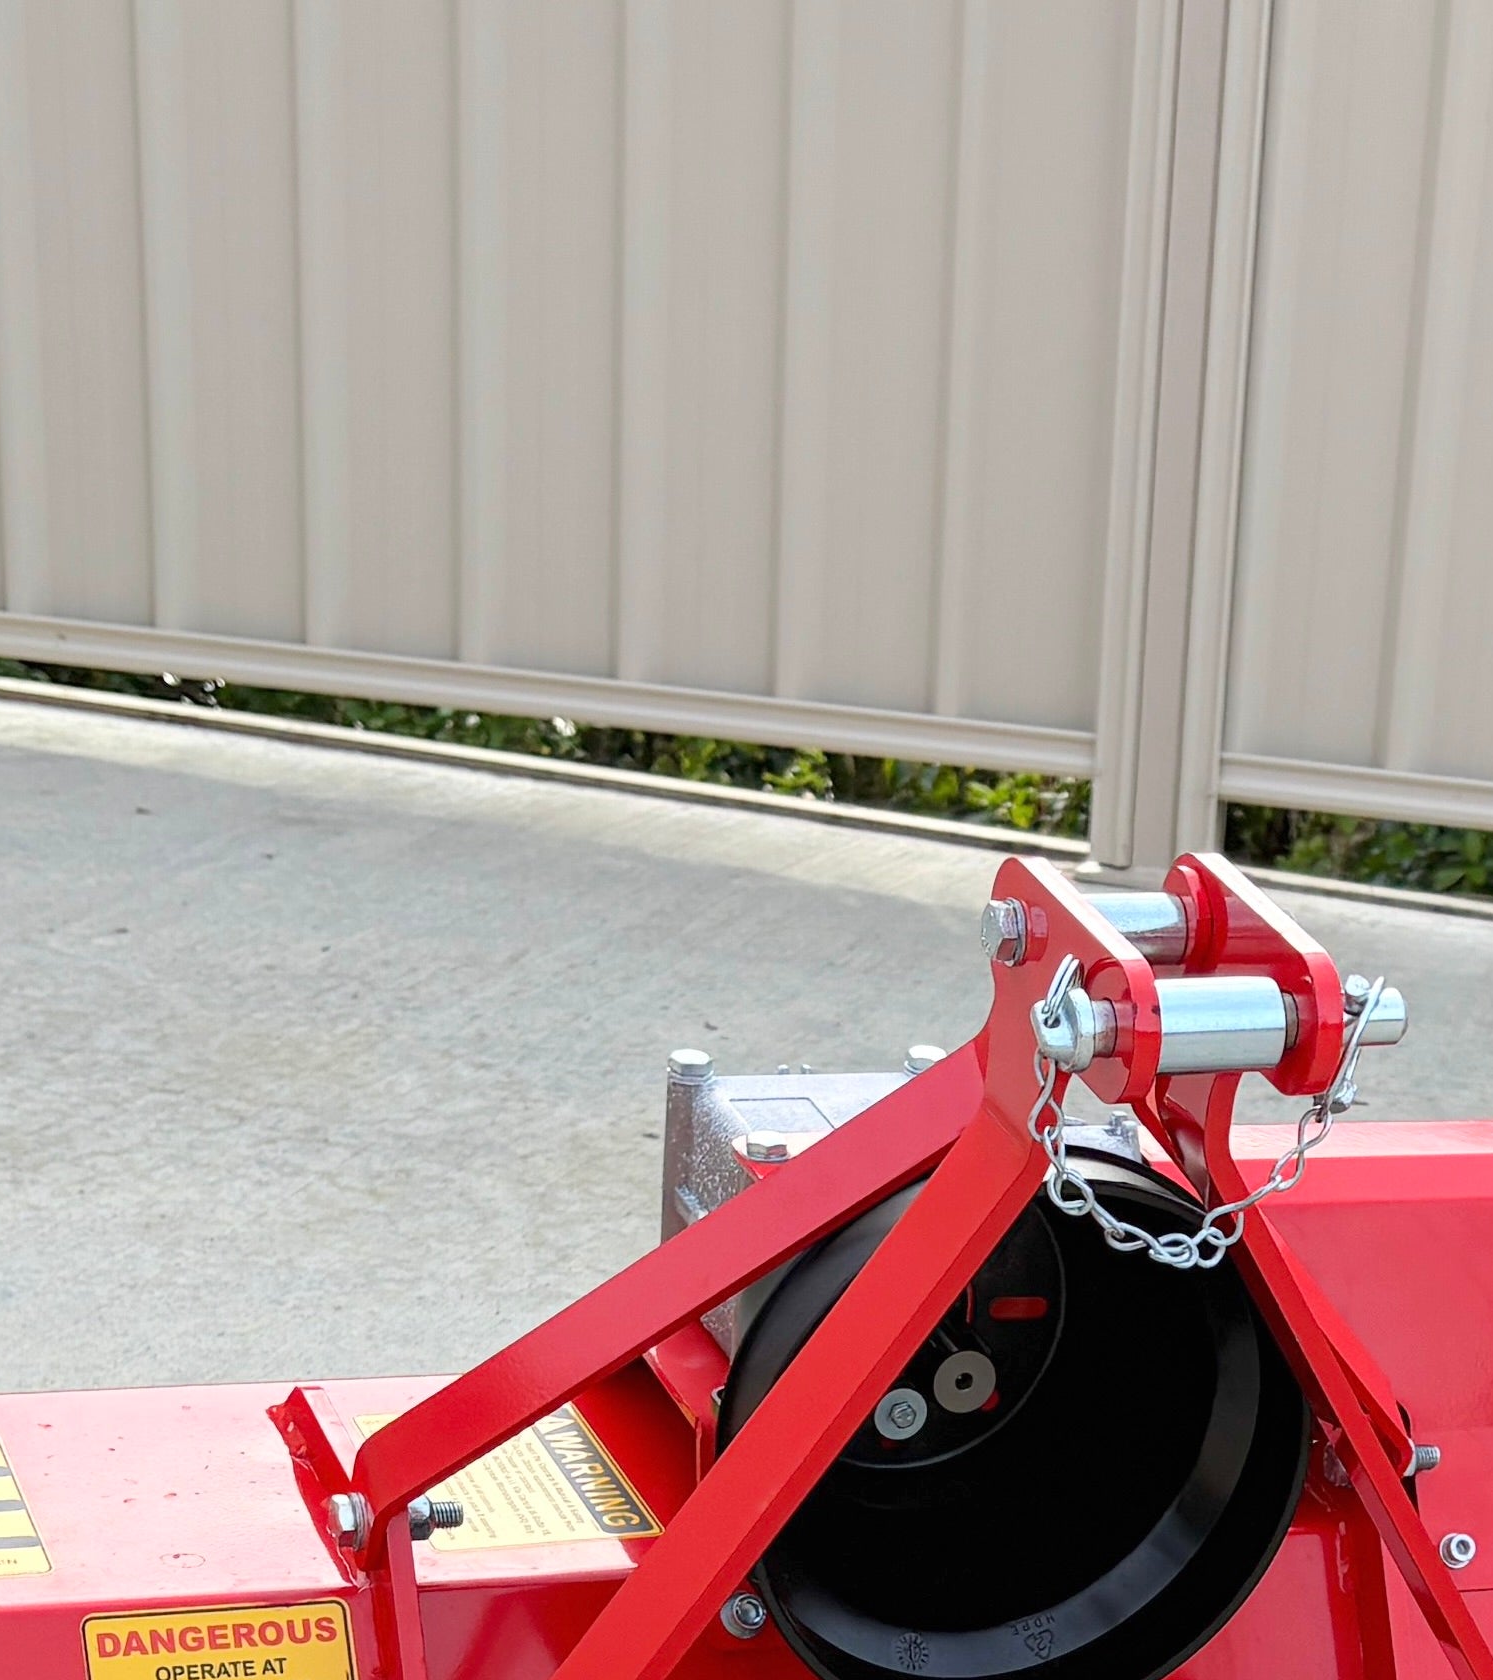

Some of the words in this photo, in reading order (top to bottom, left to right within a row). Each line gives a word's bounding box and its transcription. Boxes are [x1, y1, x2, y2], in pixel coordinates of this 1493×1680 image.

[544, 1430, 641, 1528] WARNING
[96, 1617, 337, 1658] DANGEROUS
[1009, 1612, 1056, 1636] HDPE
[262, 1658, 287, 1675] AT
